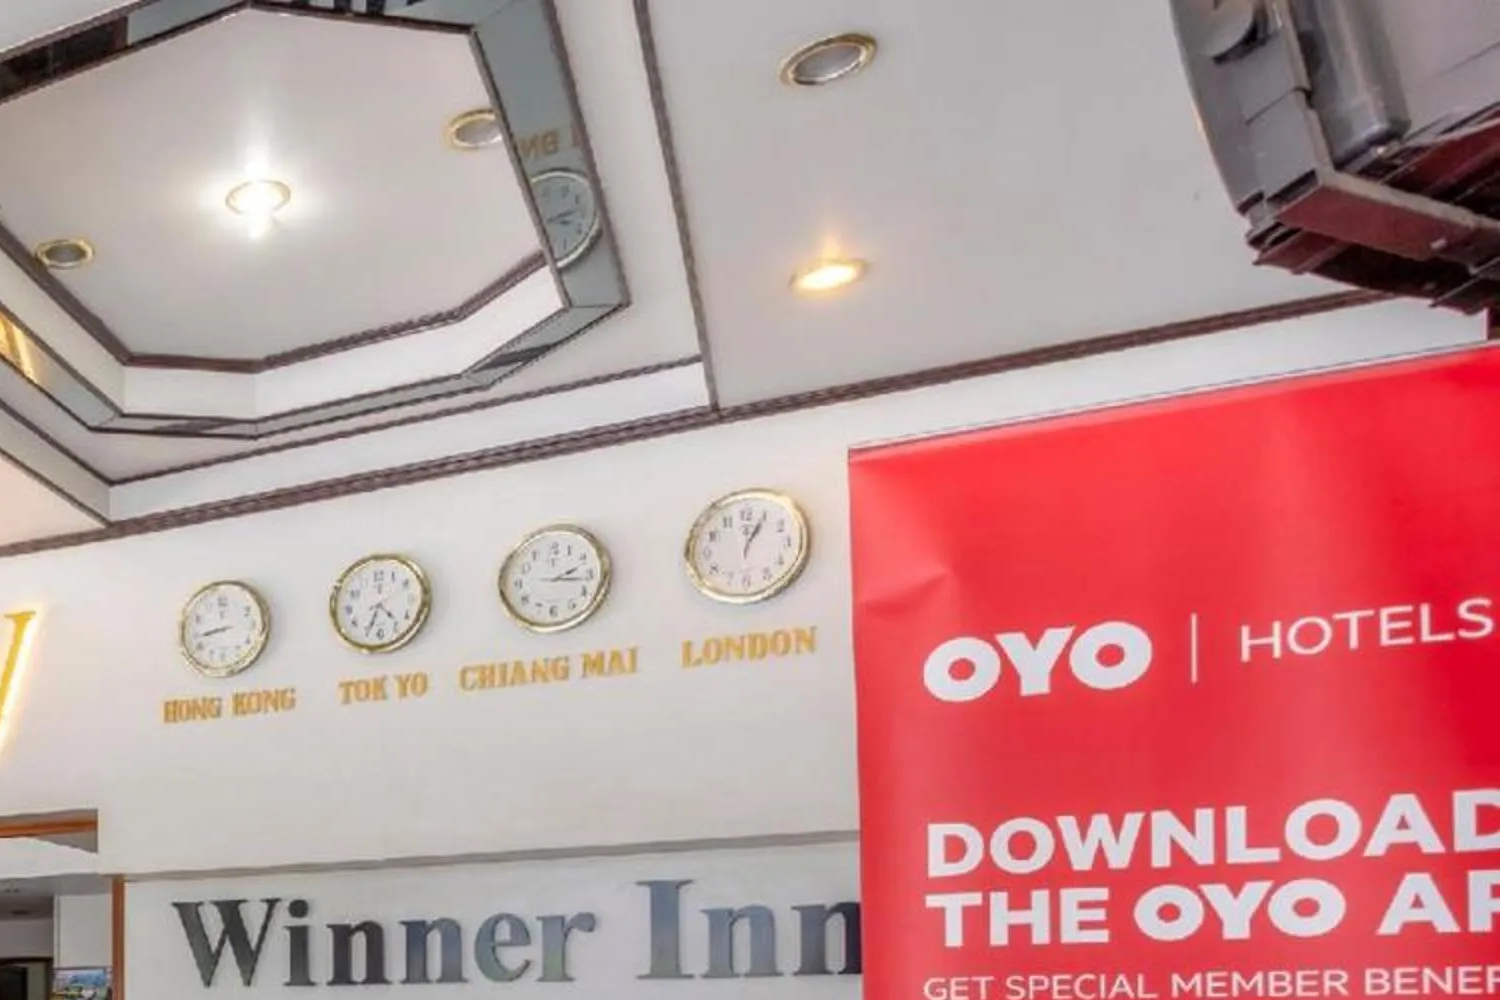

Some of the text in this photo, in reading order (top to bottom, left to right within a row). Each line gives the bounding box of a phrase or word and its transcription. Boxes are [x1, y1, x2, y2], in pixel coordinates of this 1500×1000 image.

[681, 626, 818, 669] LONDON
[923, 621, 1153, 702] OYO
[1240, 598, 1494, 662] HOTELS
[458, 647, 639, 691] CHIANG MAI
[162, 687, 297, 723] HONG KONG
[927, 789, 1500, 878] DOWNLOAD
[172, 878, 863, 987] Winner Inn
[925, 887, 1109, 947] THE
[1133, 878, 1347, 942] OYO
[1005, 974, 1157, 1000] SPECIAL
[1171, 969, 1349, 998] MEMBER
